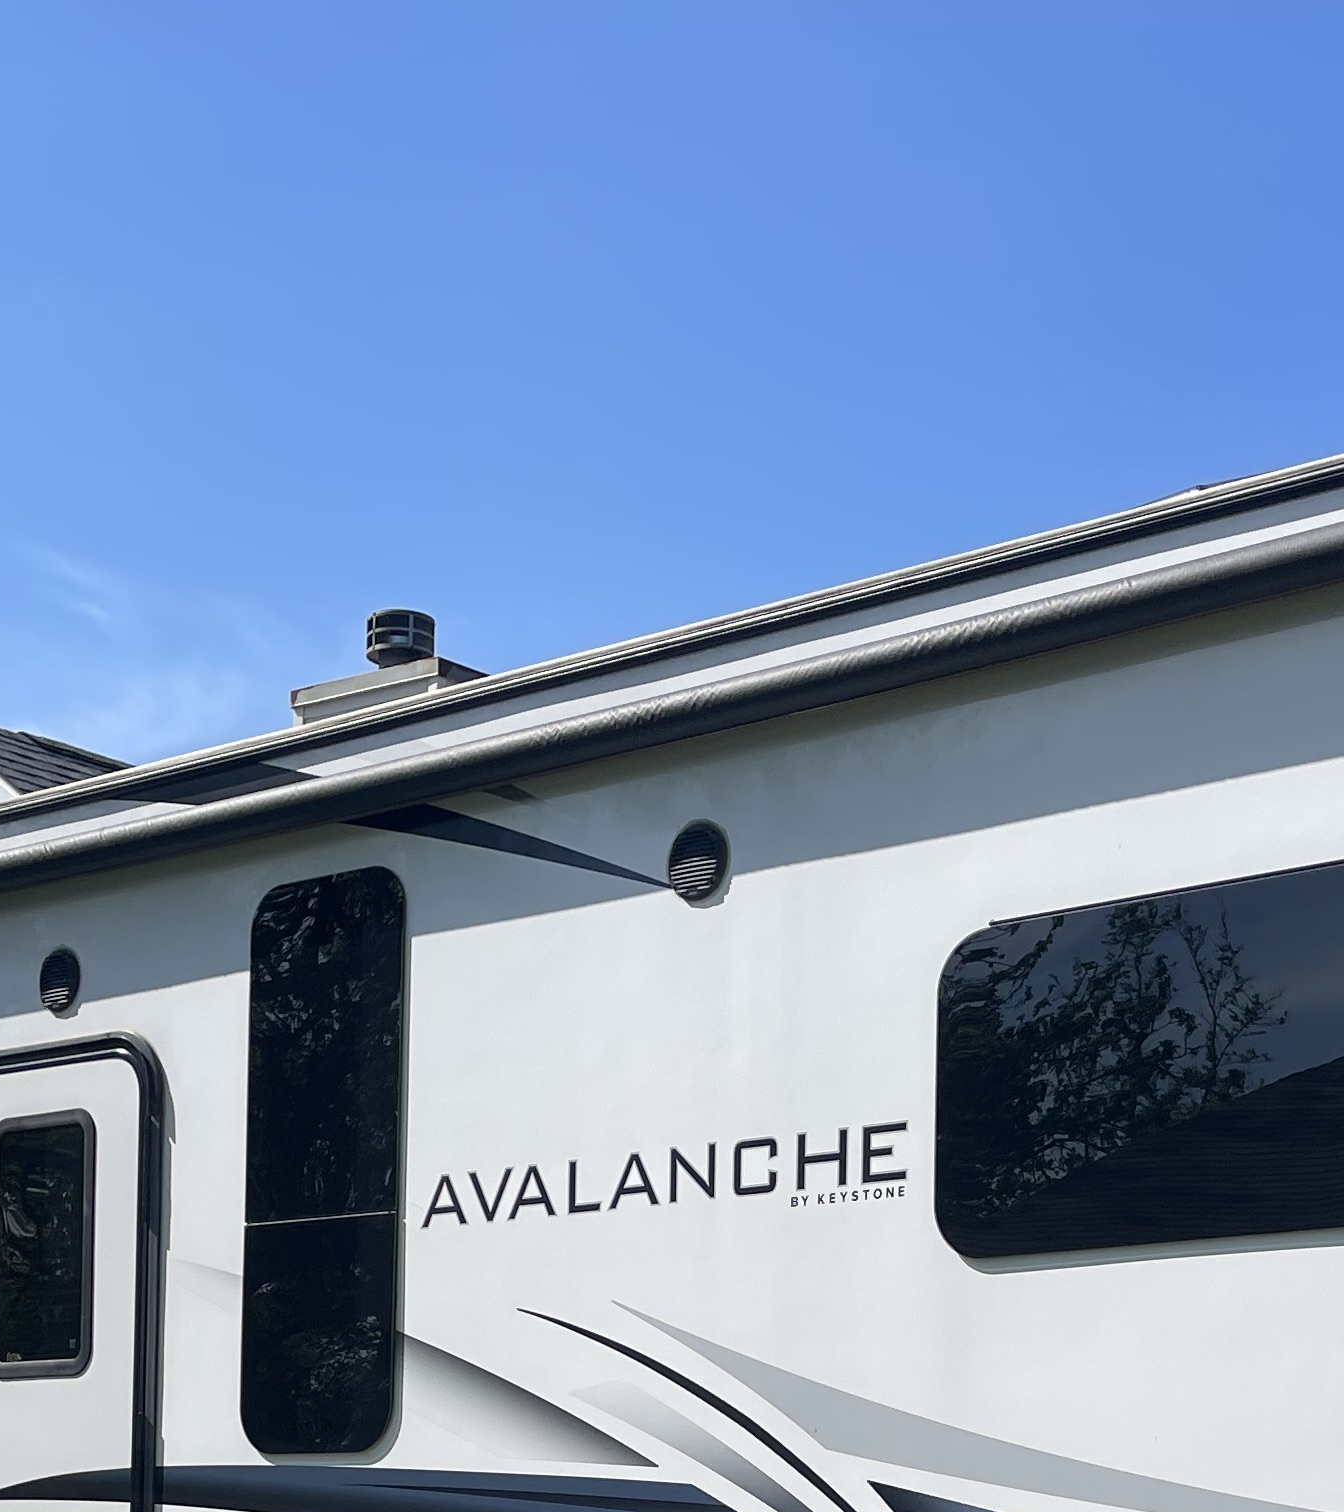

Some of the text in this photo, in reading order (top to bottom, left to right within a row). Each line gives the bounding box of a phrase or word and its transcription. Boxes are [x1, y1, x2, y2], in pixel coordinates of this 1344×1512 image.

[420, 1120, 909, 1229] AVALANCHE
[790, 1186, 905, 1207] BY KEYSTONE
